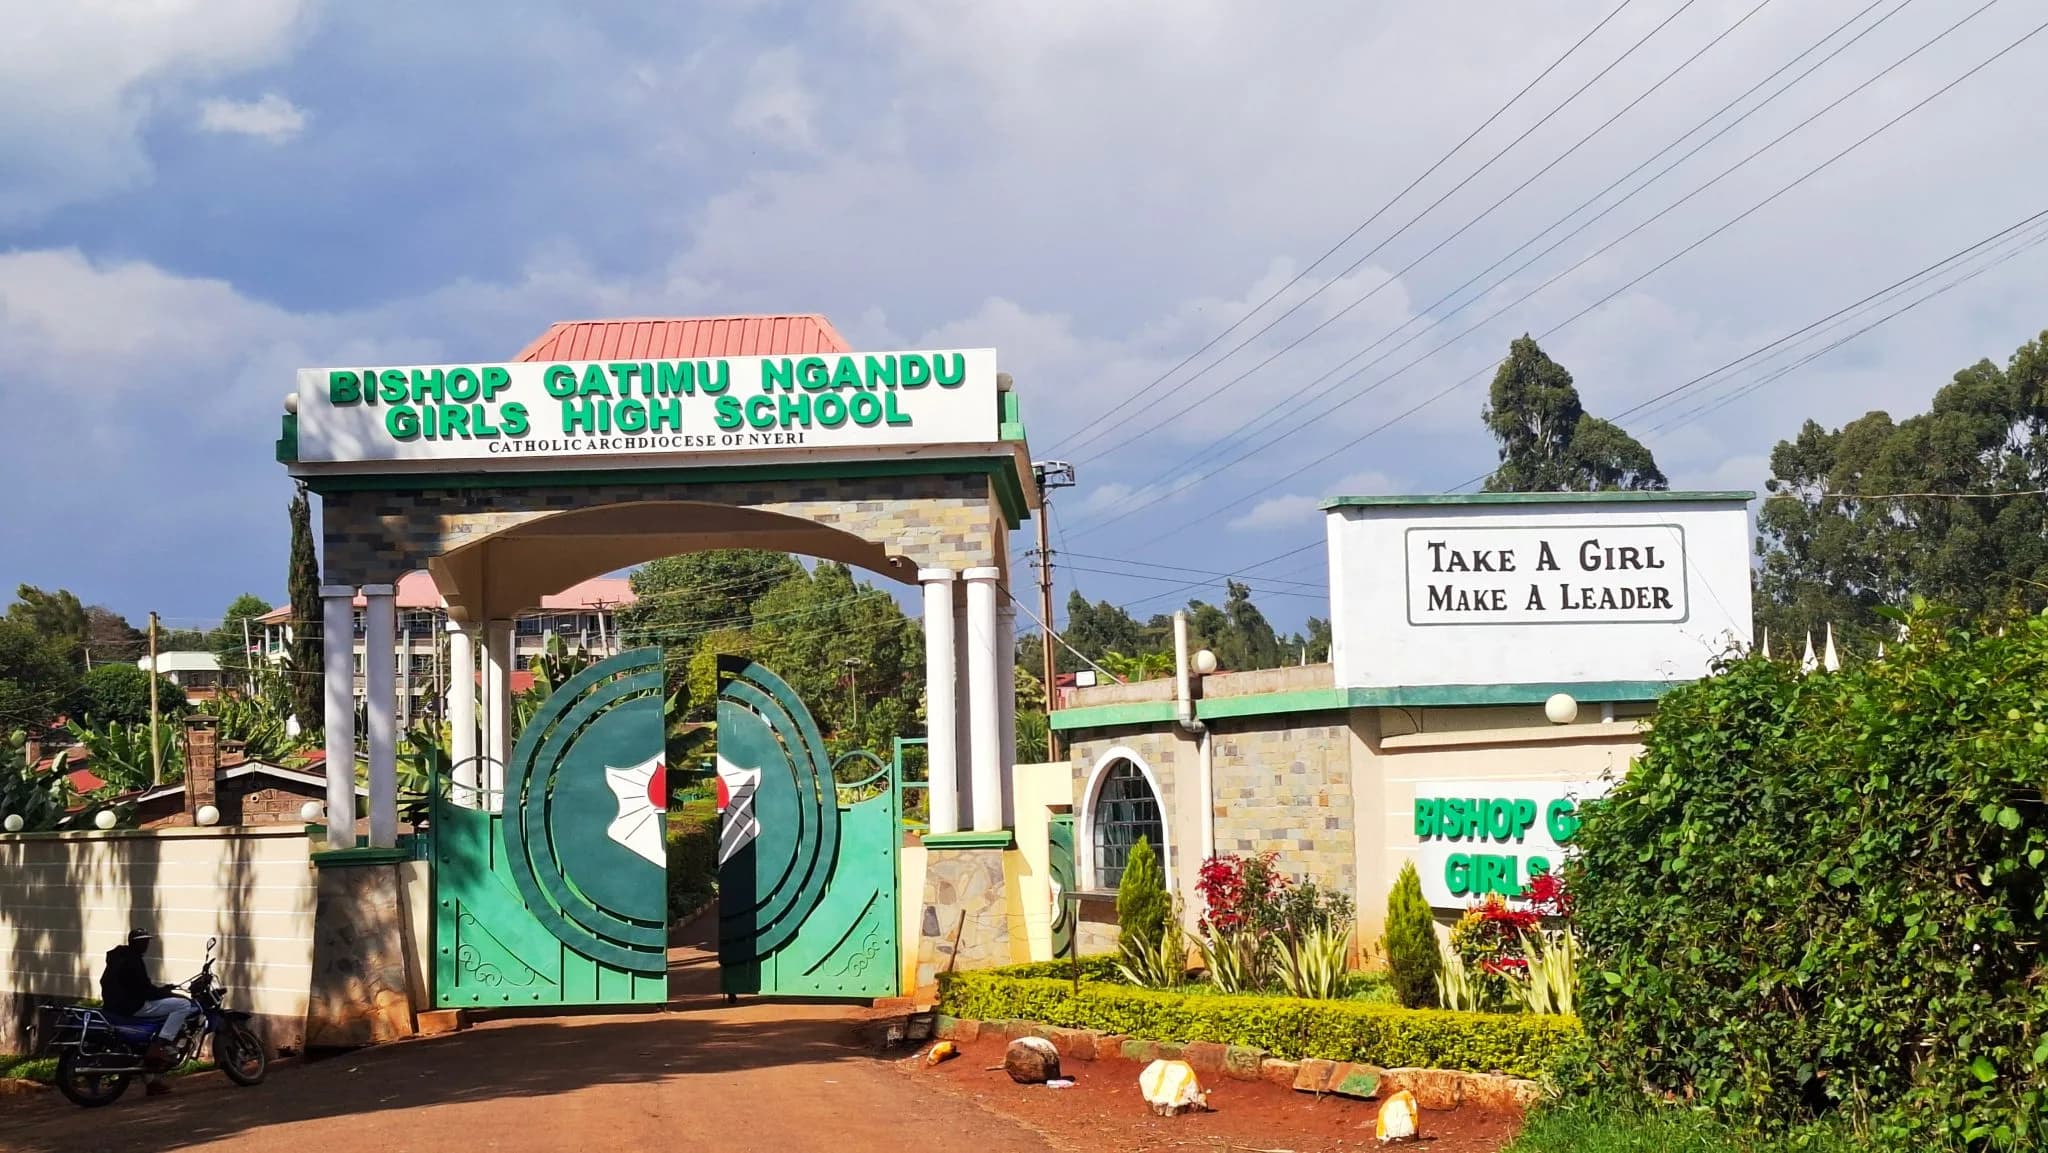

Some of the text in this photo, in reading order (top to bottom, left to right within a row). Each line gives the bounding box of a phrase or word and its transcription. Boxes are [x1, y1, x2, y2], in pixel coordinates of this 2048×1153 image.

[329, 353, 965, 404] BISHOP GATIMU NGANDU
[385, 390, 911, 438] GIRLS HIGH SCHOOL
[488, 432, 804, 453] CATHOLIC ARCHDIOCESE OF NYERI
[1427, 538, 1666, 573] TAKE A GIRL
[1427, 583, 1674, 612] MAKE A LEADER
[1414, 798, 1537, 841] BISHOP
